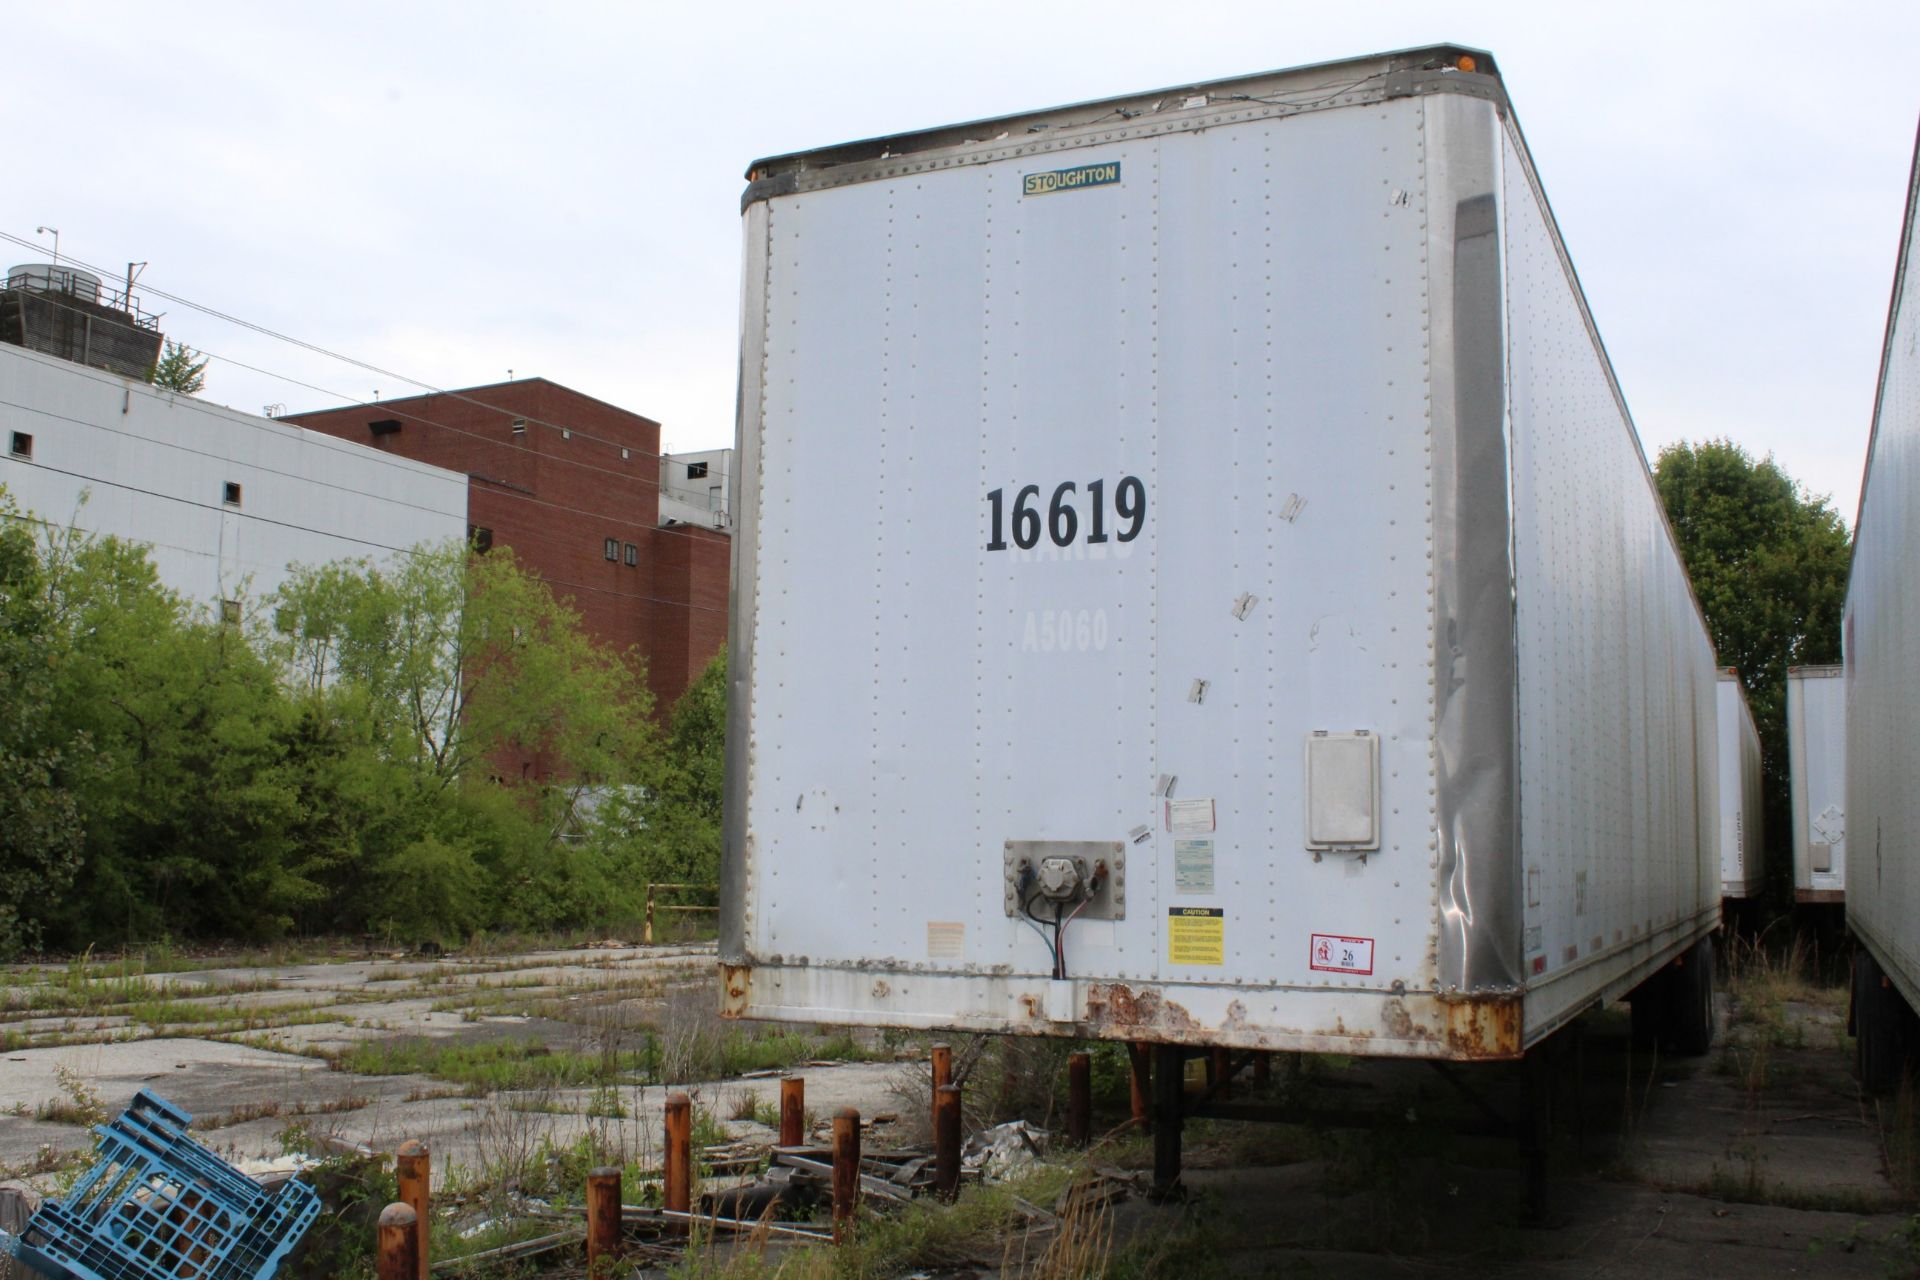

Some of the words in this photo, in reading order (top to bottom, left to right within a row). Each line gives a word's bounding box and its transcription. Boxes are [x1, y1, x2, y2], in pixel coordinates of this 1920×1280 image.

[1026, 165, 1116, 191] STOUGHTON
[986, 475, 1147, 552] 16619
[1021, 607, 1108, 653] A5060
[1182, 908, 1211, 916] CAUTION
[1342, 949, 1354, 961] 26
